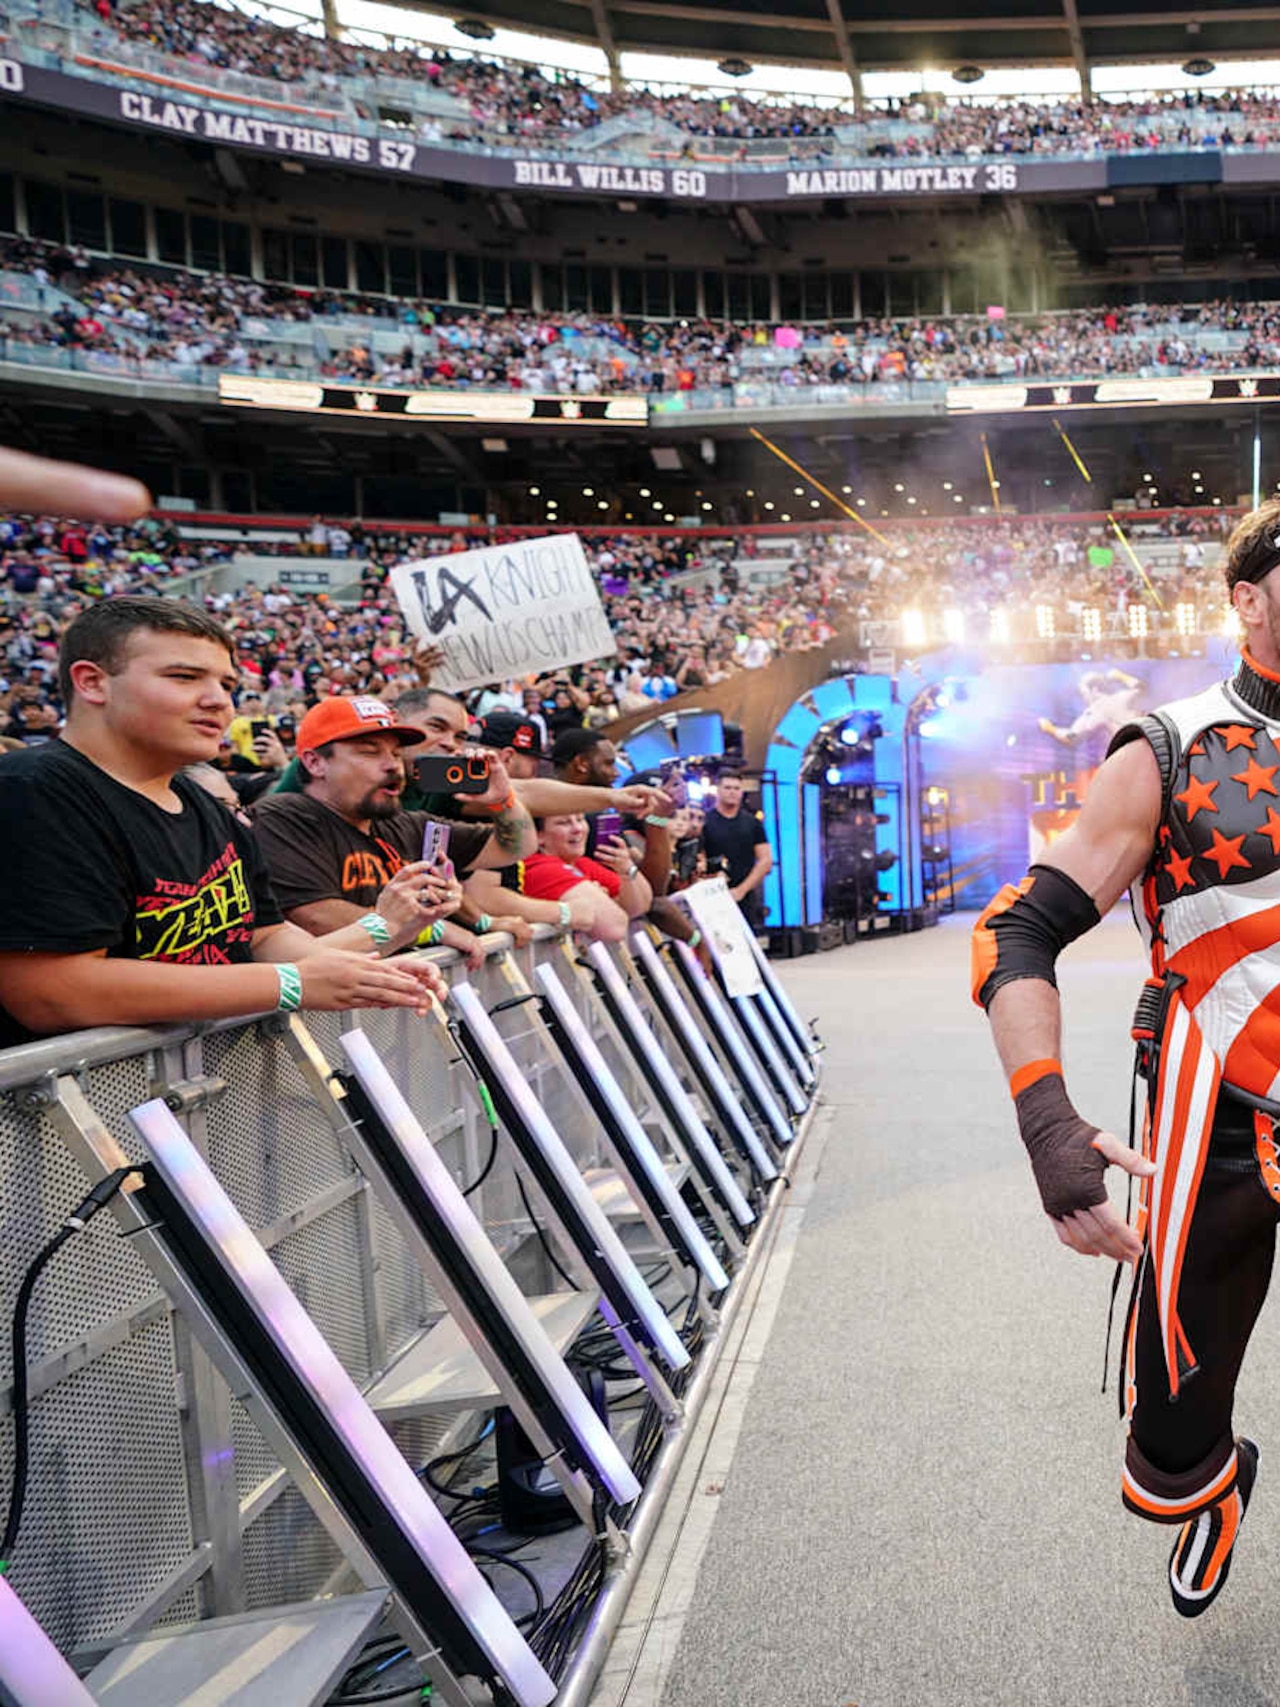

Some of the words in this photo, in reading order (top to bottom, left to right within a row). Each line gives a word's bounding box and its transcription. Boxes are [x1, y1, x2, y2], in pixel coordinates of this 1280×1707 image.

[120, 92, 199, 133] CLAY
[204, 112, 370, 162] MATTHEWS
[378, 140, 416, 171] 57
[514, 161, 573, 187] BILL
[577, 165, 665, 192] WILLIS
[672, 170, 706, 197] 60
[786, 169, 877, 195] MARION
[881, 166, 978, 191] MOTLEY
[985, 164, 1016, 190] 36
[411, 566, 493, 635] LA
[483, 543, 587, 607] KNIGHT
[438, 632, 495, 687] NEW
[526, 606, 601, 658] CHAMP
